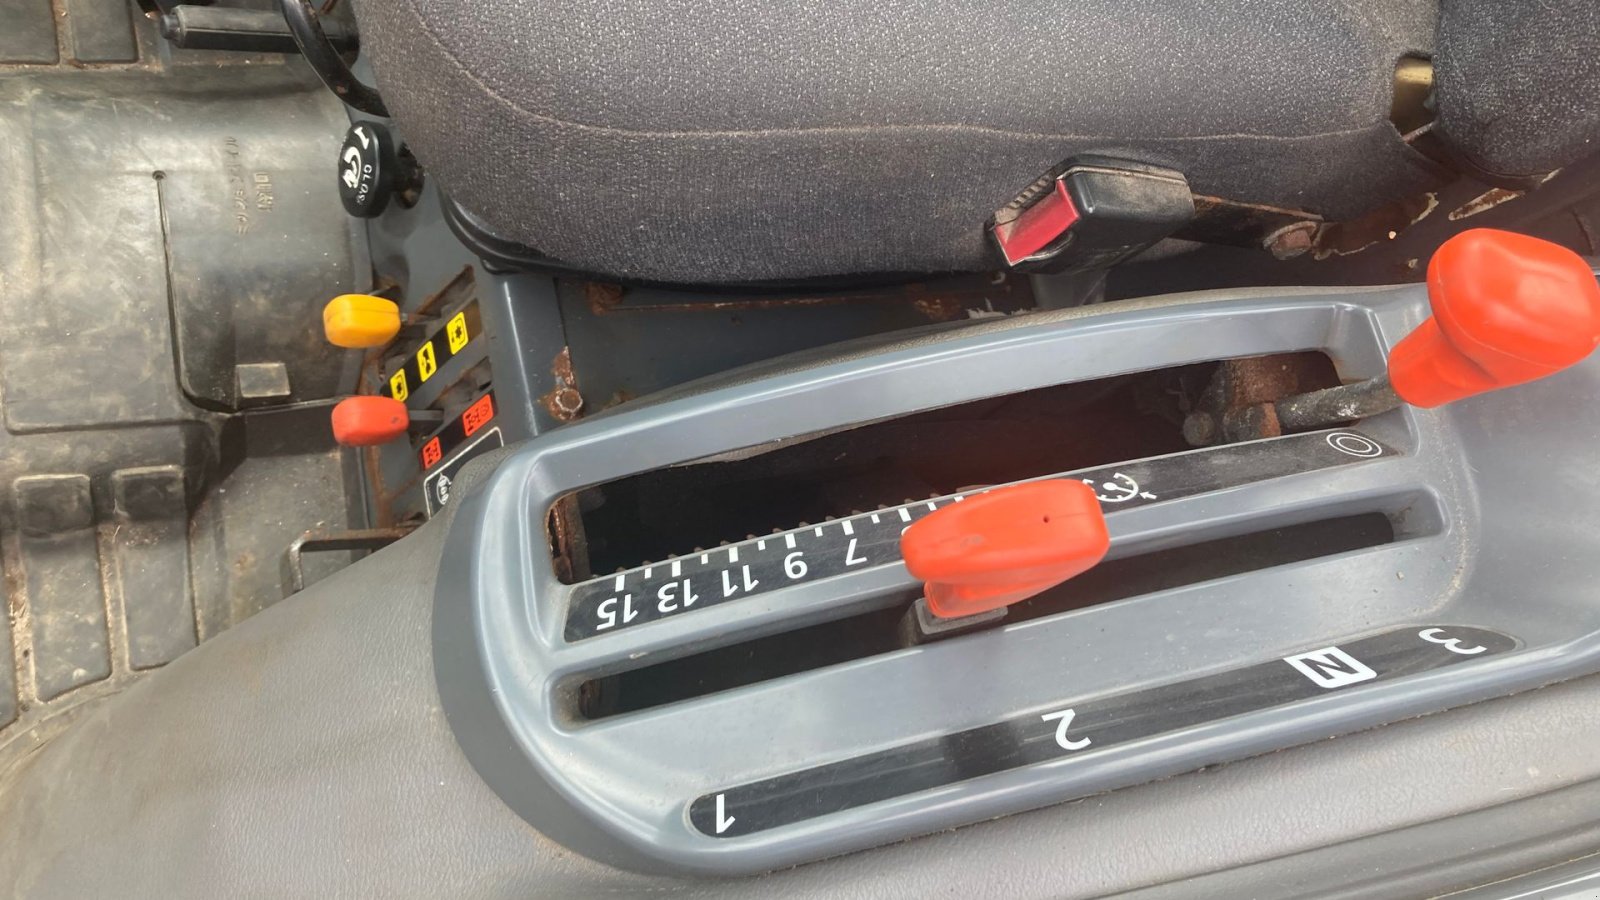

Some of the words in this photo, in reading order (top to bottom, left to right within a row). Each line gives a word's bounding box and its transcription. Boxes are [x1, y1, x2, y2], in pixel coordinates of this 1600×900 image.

[783, 551, 808, 580] 9
[845, 538, 868, 566] 7
[657, 579, 699, 613] 13
[721, 565, 760, 598] 11
[596, 594, 639, 631] 15
[1418, 627, 1488, 655] 3
[1298, 653, 1360, 681] N
[1040, 708, 1092, 751] 2
[715, 793, 736, 834] 1
